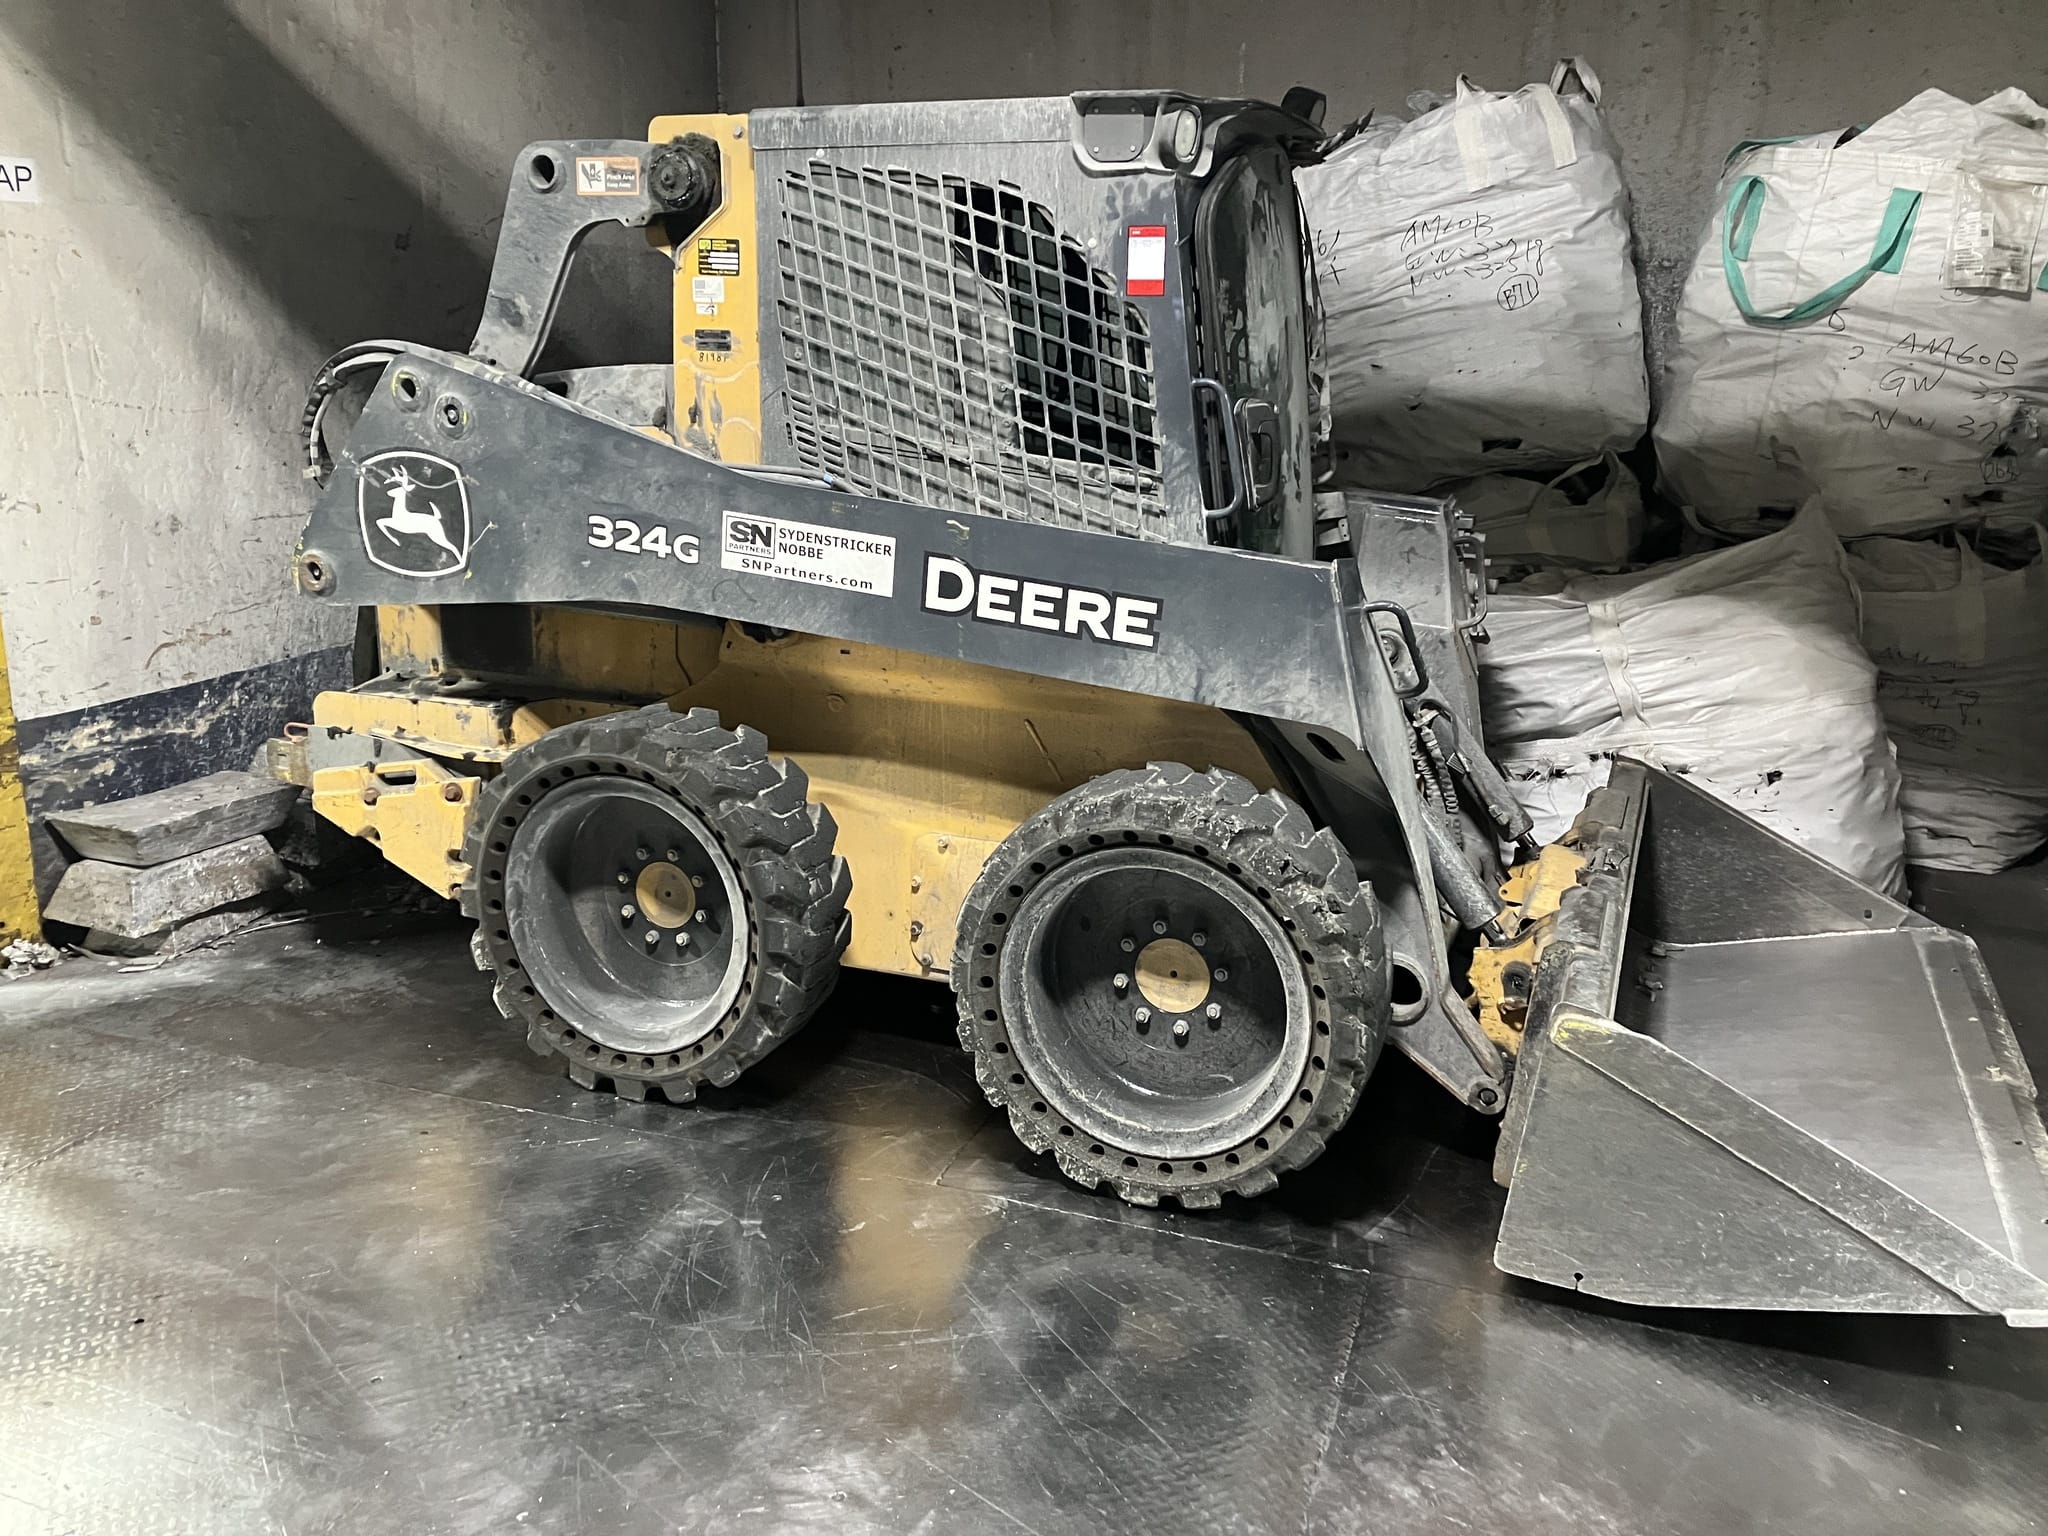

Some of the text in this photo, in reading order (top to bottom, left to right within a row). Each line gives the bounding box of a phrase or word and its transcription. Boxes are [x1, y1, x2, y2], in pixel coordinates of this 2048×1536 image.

[1886, 332, 2019, 375] AM60B
[587, 514, 700, 565] 324G
[728, 542, 772, 556] PARTNERS
[729, 520, 772, 548] SN
[778, 527, 893, 558] SYDENSTRICKER
[778, 542, 824, 560] NOBBE
[741, 558, 874, 591] SNPartners.com
[924, 555, 1159, 648] DEERE
